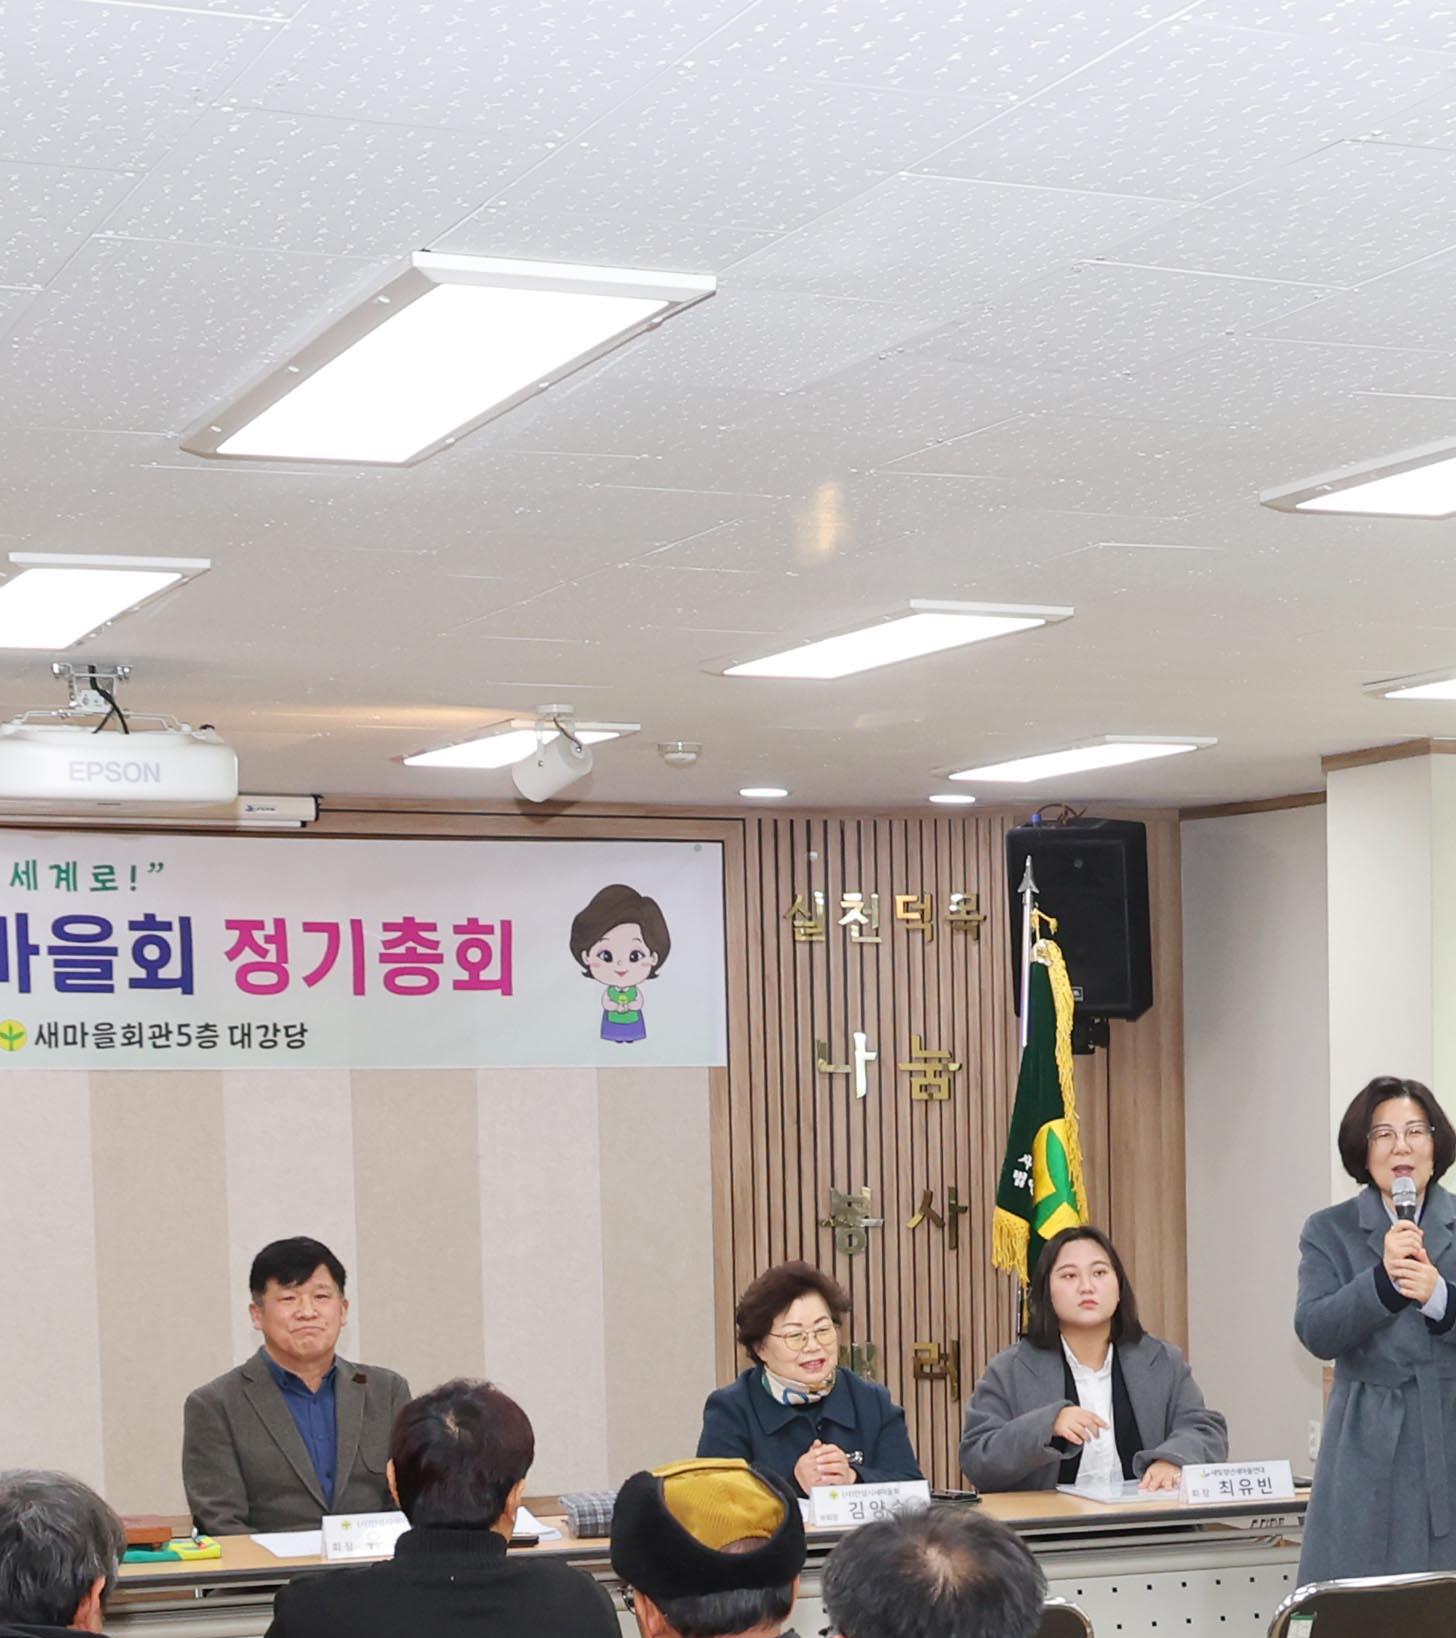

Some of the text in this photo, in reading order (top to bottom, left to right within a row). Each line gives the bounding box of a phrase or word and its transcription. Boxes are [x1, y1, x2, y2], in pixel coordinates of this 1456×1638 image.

[68, 761, 161, 783] EPSON
[783, 891, 987, 943] 실천덕목
[223, 915, 514, 997] 정기총회
[33, 1020, 221, 1050] 새마을회관5층
[227, 1021, 309, 1050] 대강당
[817, 1031, 962, 1101] 나눔
[819, 1186, 969, 1254] 봉사
[1219, 1476, 1273, 1497] 최유빈
